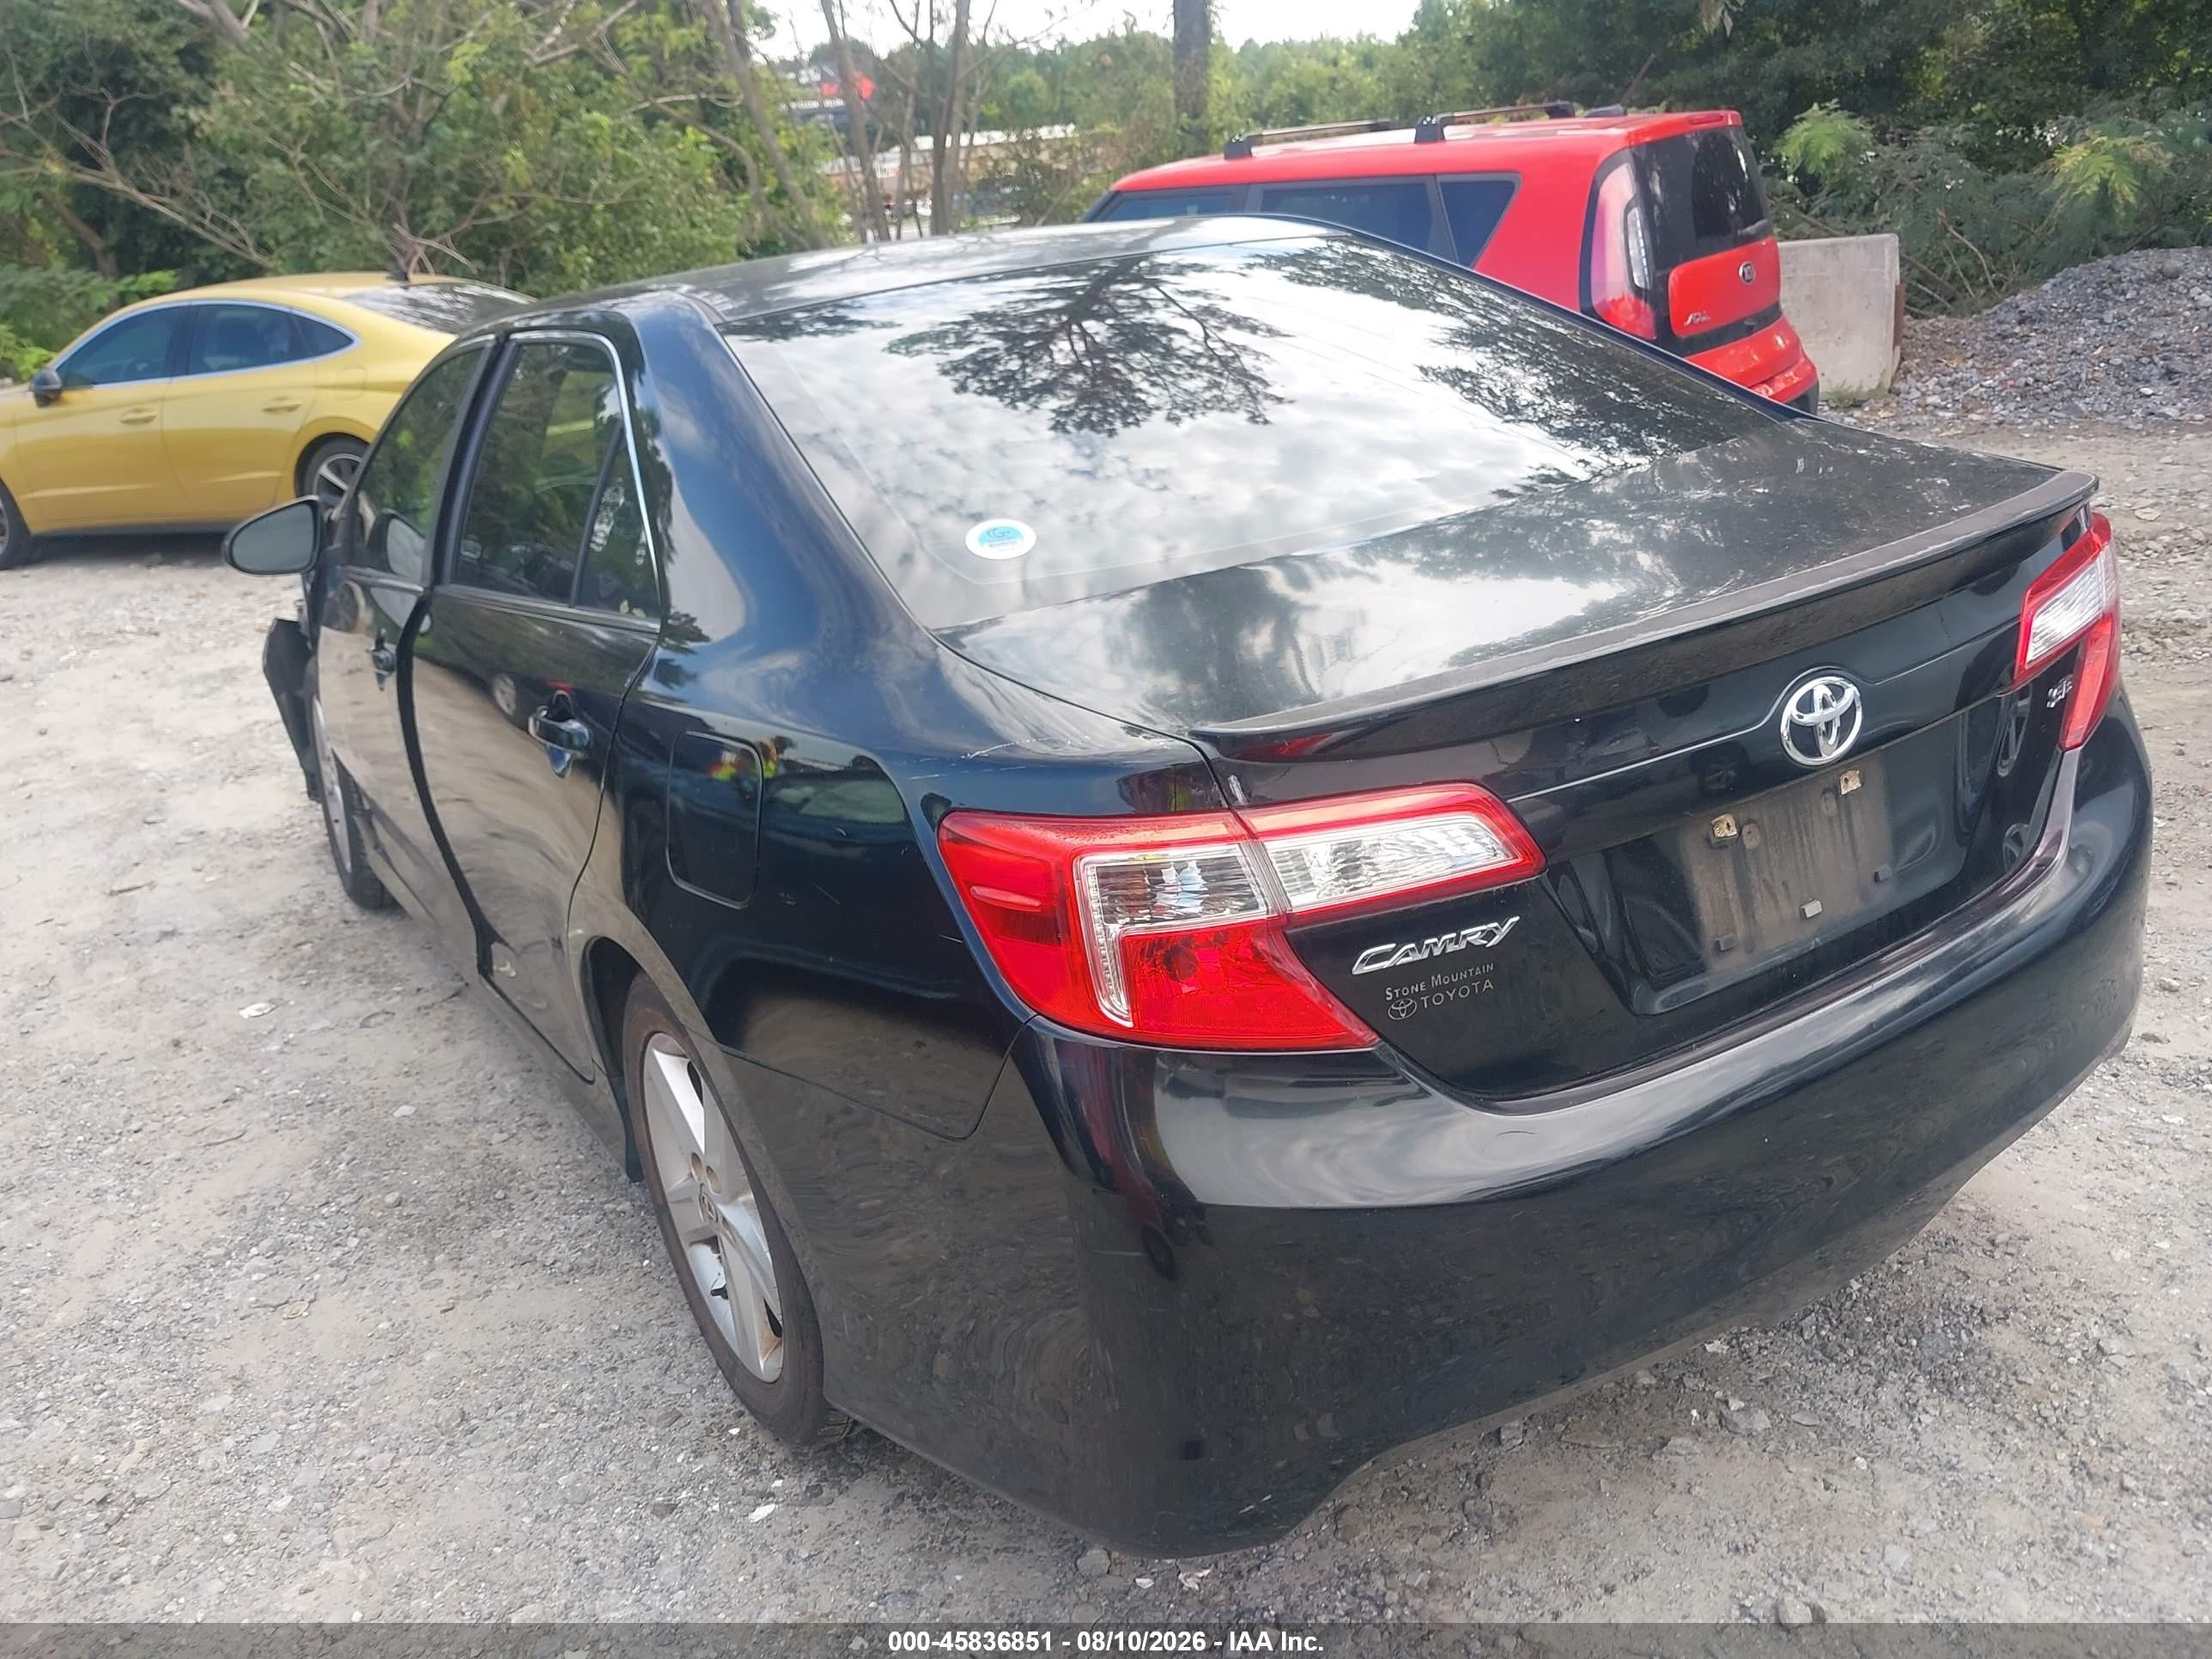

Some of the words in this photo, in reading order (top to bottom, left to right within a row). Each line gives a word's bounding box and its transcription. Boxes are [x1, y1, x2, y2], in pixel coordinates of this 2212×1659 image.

[1352, 916, 1520, 975] CAMRY
[1386, 981, 1427, 1001] STONE
[1431, 963, 1494, 988] MOUNTAIN
[1420, 979, 1494, 1009] TOYOTA
